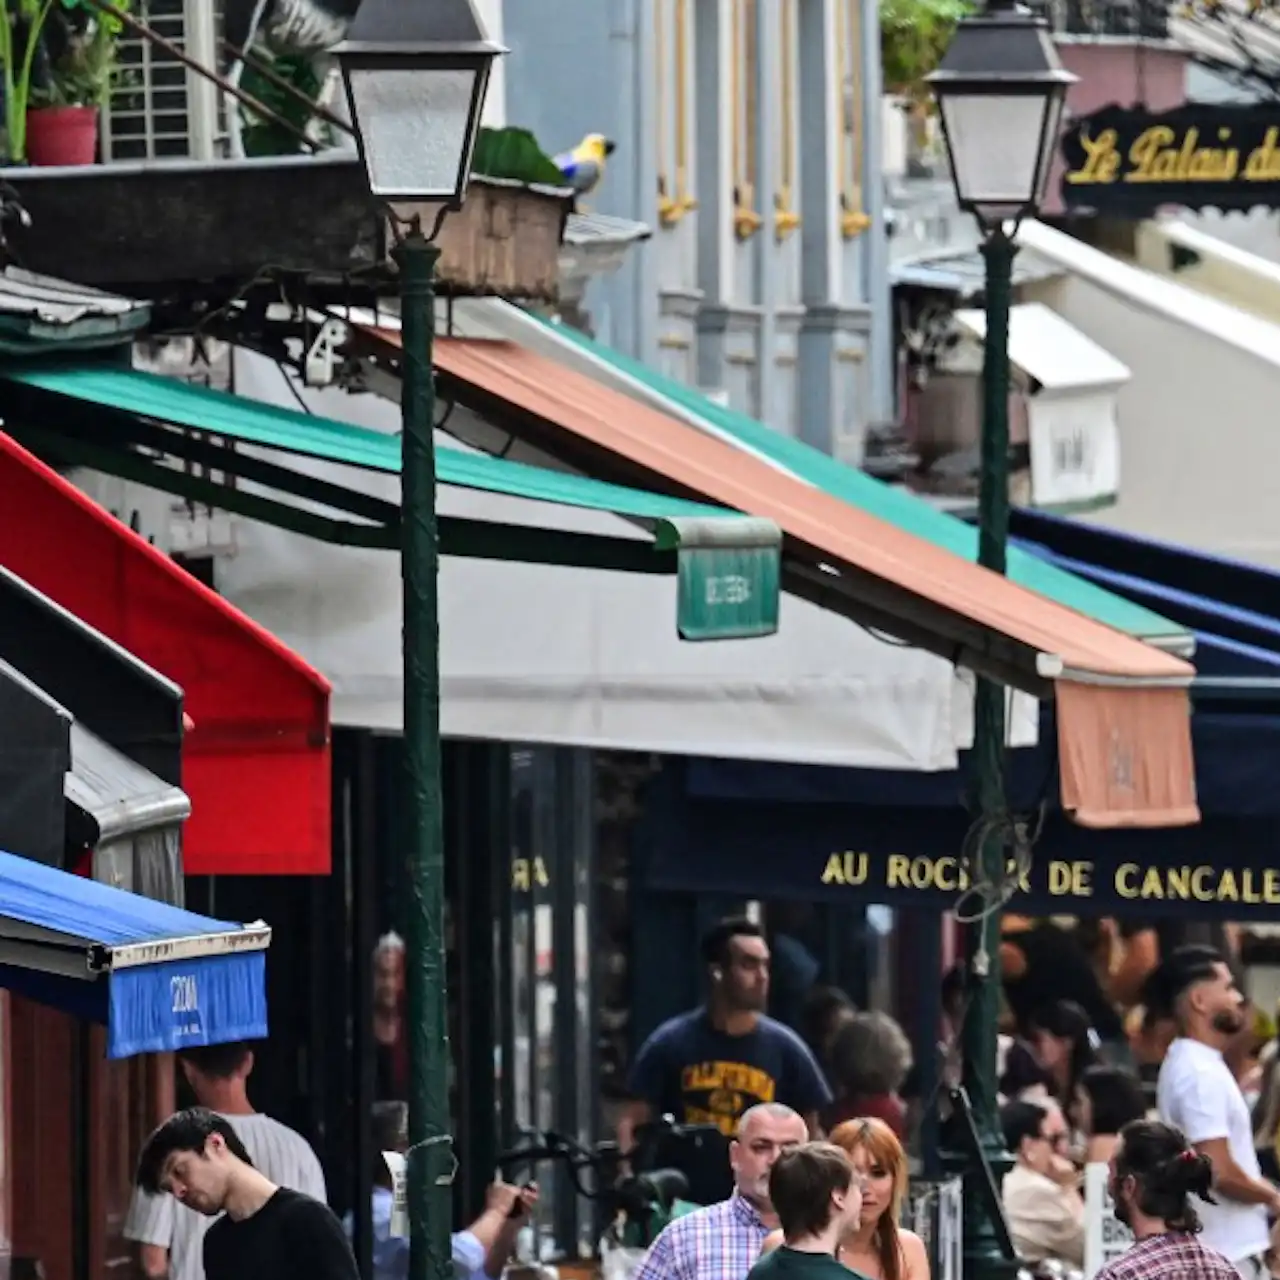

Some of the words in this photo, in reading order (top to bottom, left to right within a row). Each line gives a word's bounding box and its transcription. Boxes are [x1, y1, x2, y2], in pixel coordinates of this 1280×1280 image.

[1067, 128, 1121, 183] Le
[1125, 126, 1239, 182] Palais
[821, 850, 869, 886] AU
[1048, 860, 1095, 897] DE
